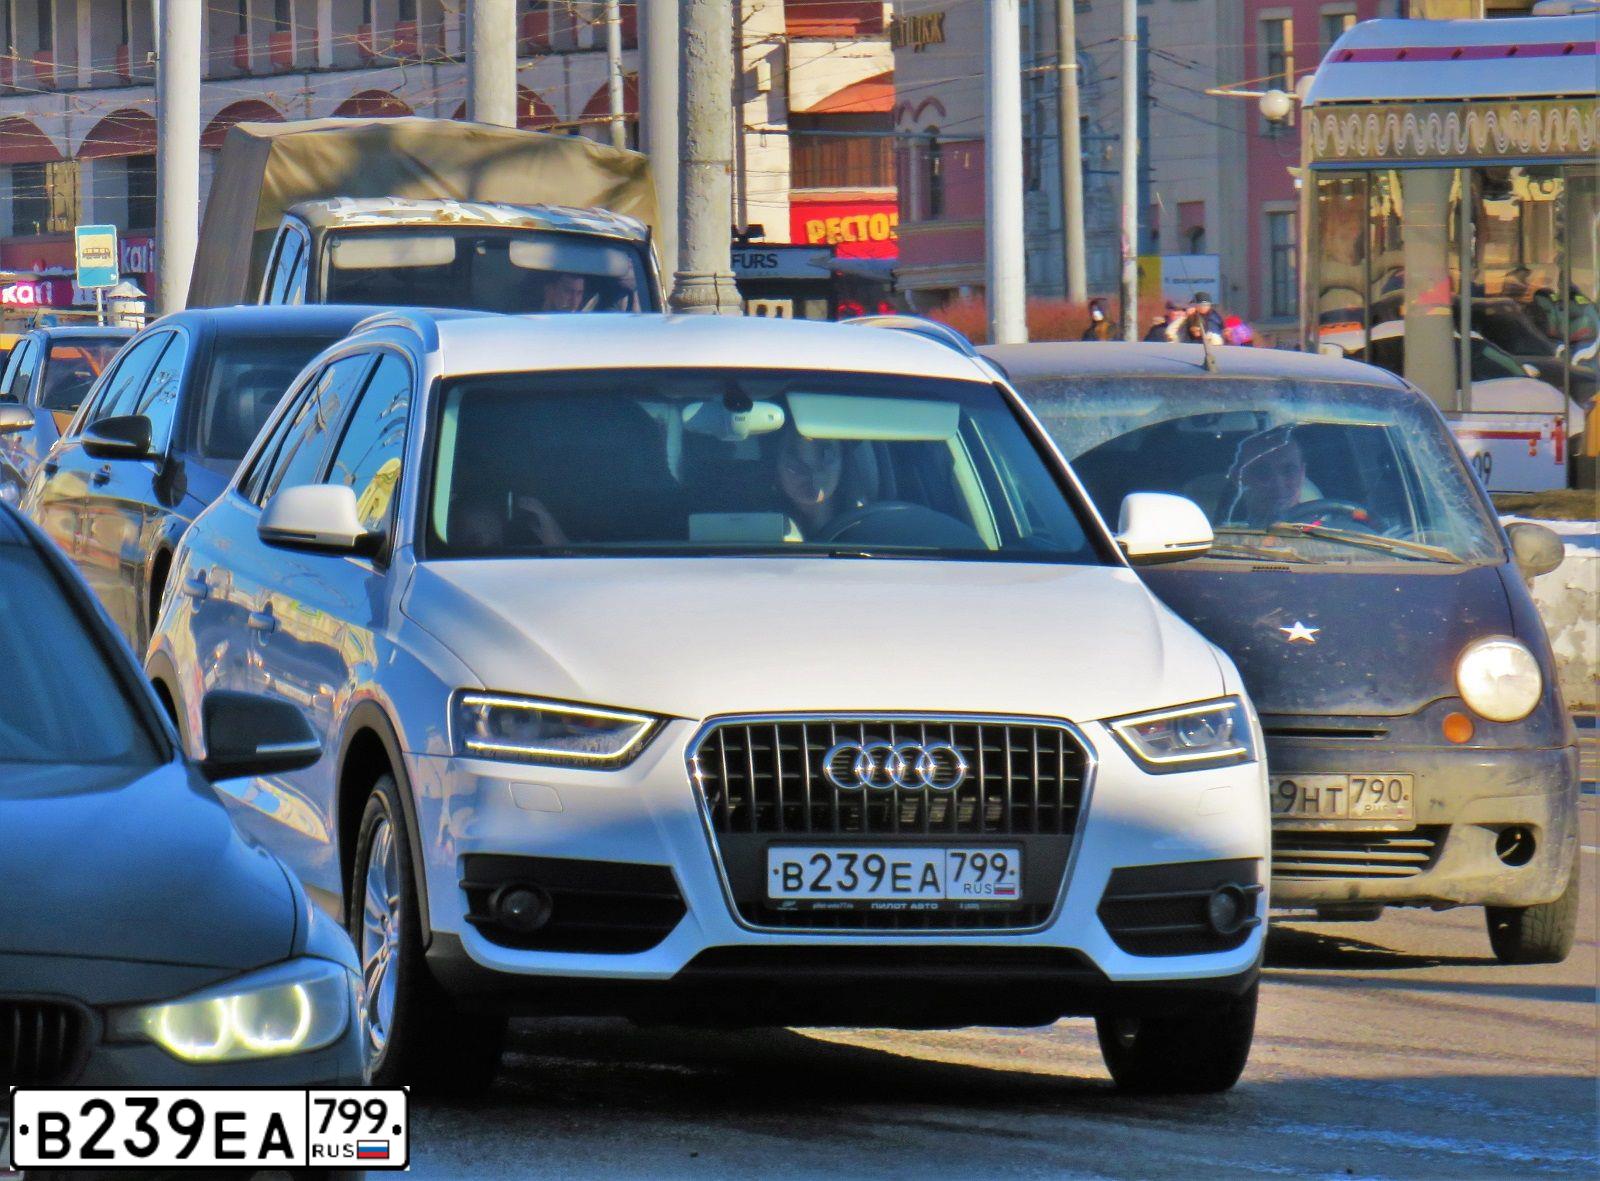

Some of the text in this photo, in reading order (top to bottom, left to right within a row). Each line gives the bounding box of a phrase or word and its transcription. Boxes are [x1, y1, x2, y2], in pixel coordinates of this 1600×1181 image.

[731, 253, 779, 269] FURS
[1352, 778, 1402, 804] 790
[782, 852, 1008, 892] В239ЕА 799
[963, 882, 992, 894] RUS
